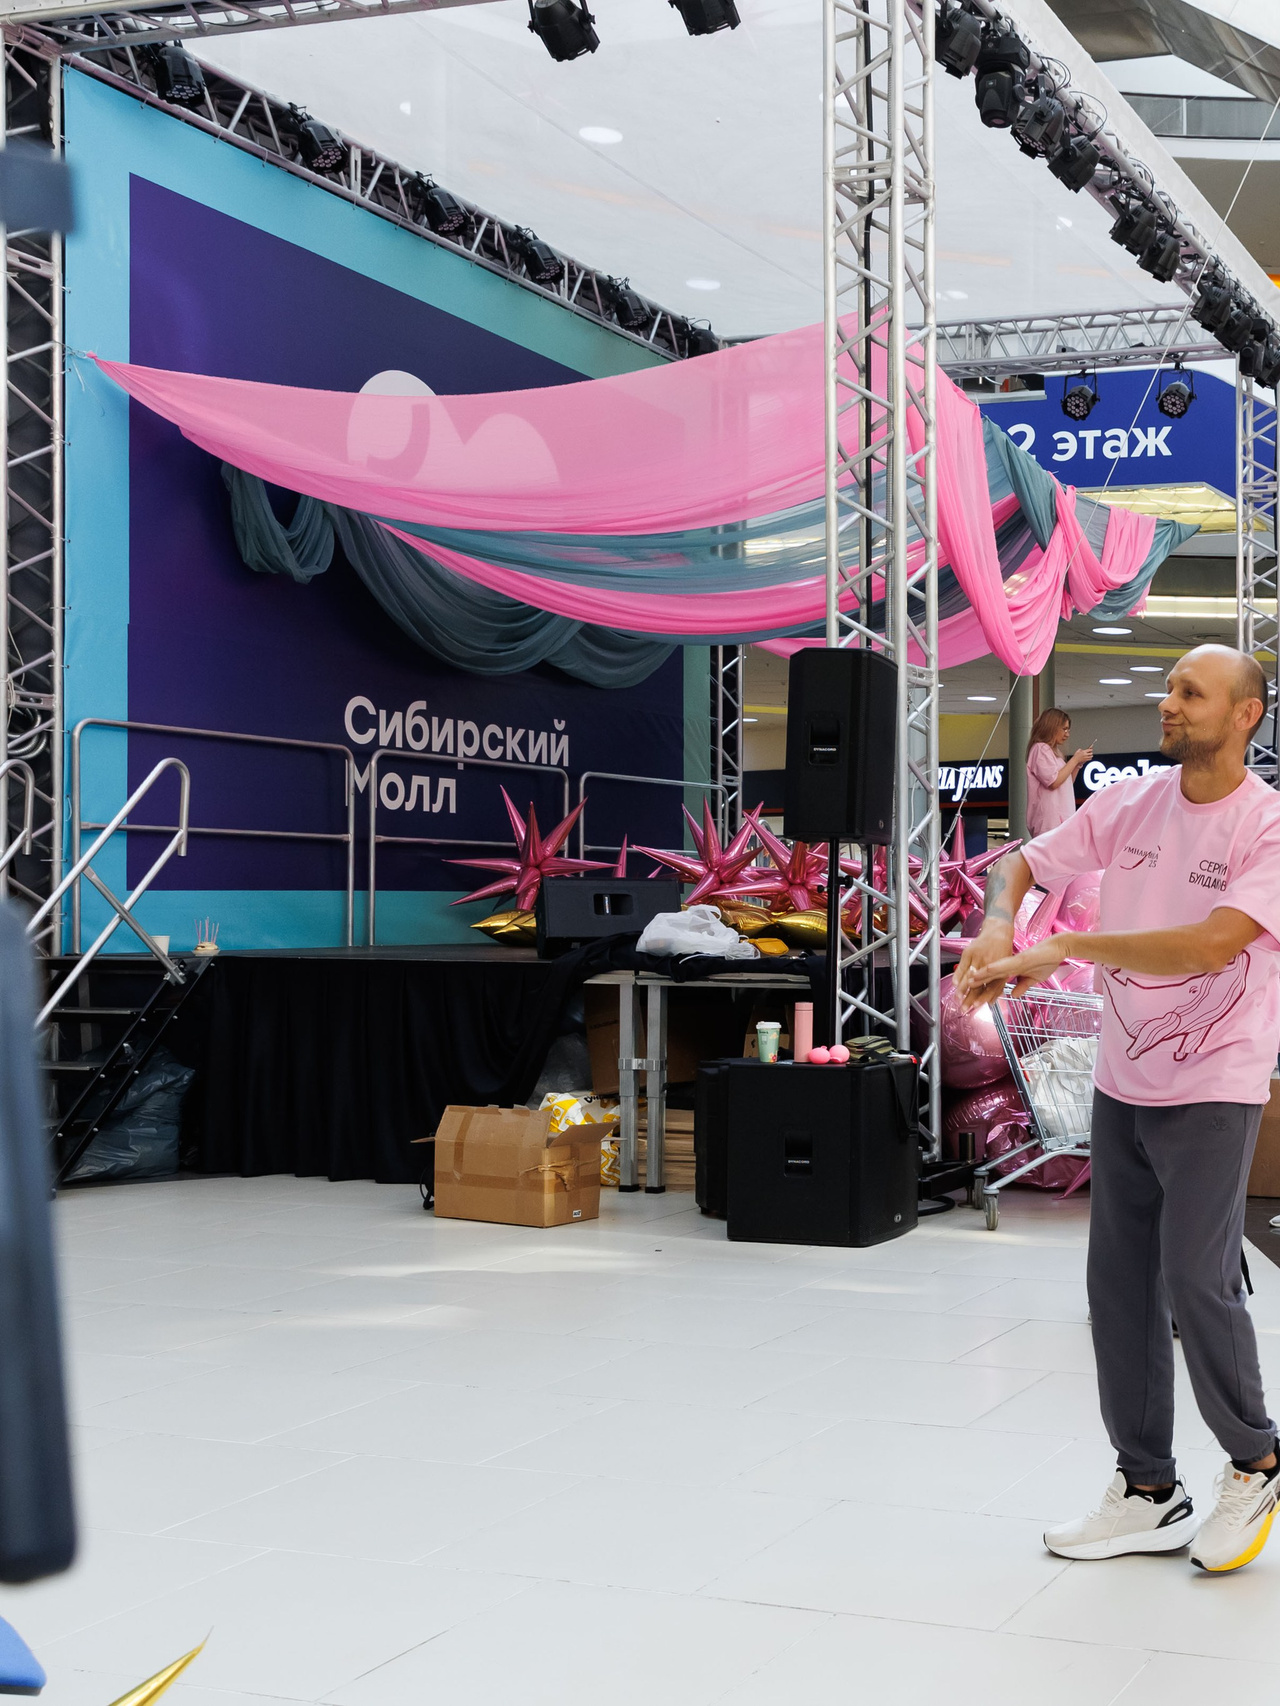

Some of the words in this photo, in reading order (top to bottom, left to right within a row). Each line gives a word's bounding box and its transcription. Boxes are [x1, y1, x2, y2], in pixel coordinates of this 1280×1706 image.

[1007, 423, 1036, 461] 2
[1051, 426, 1173, 462] этаж
[344, 695, 569, 770] Сибирский
[952, 765, 1004, 802] JEANS
